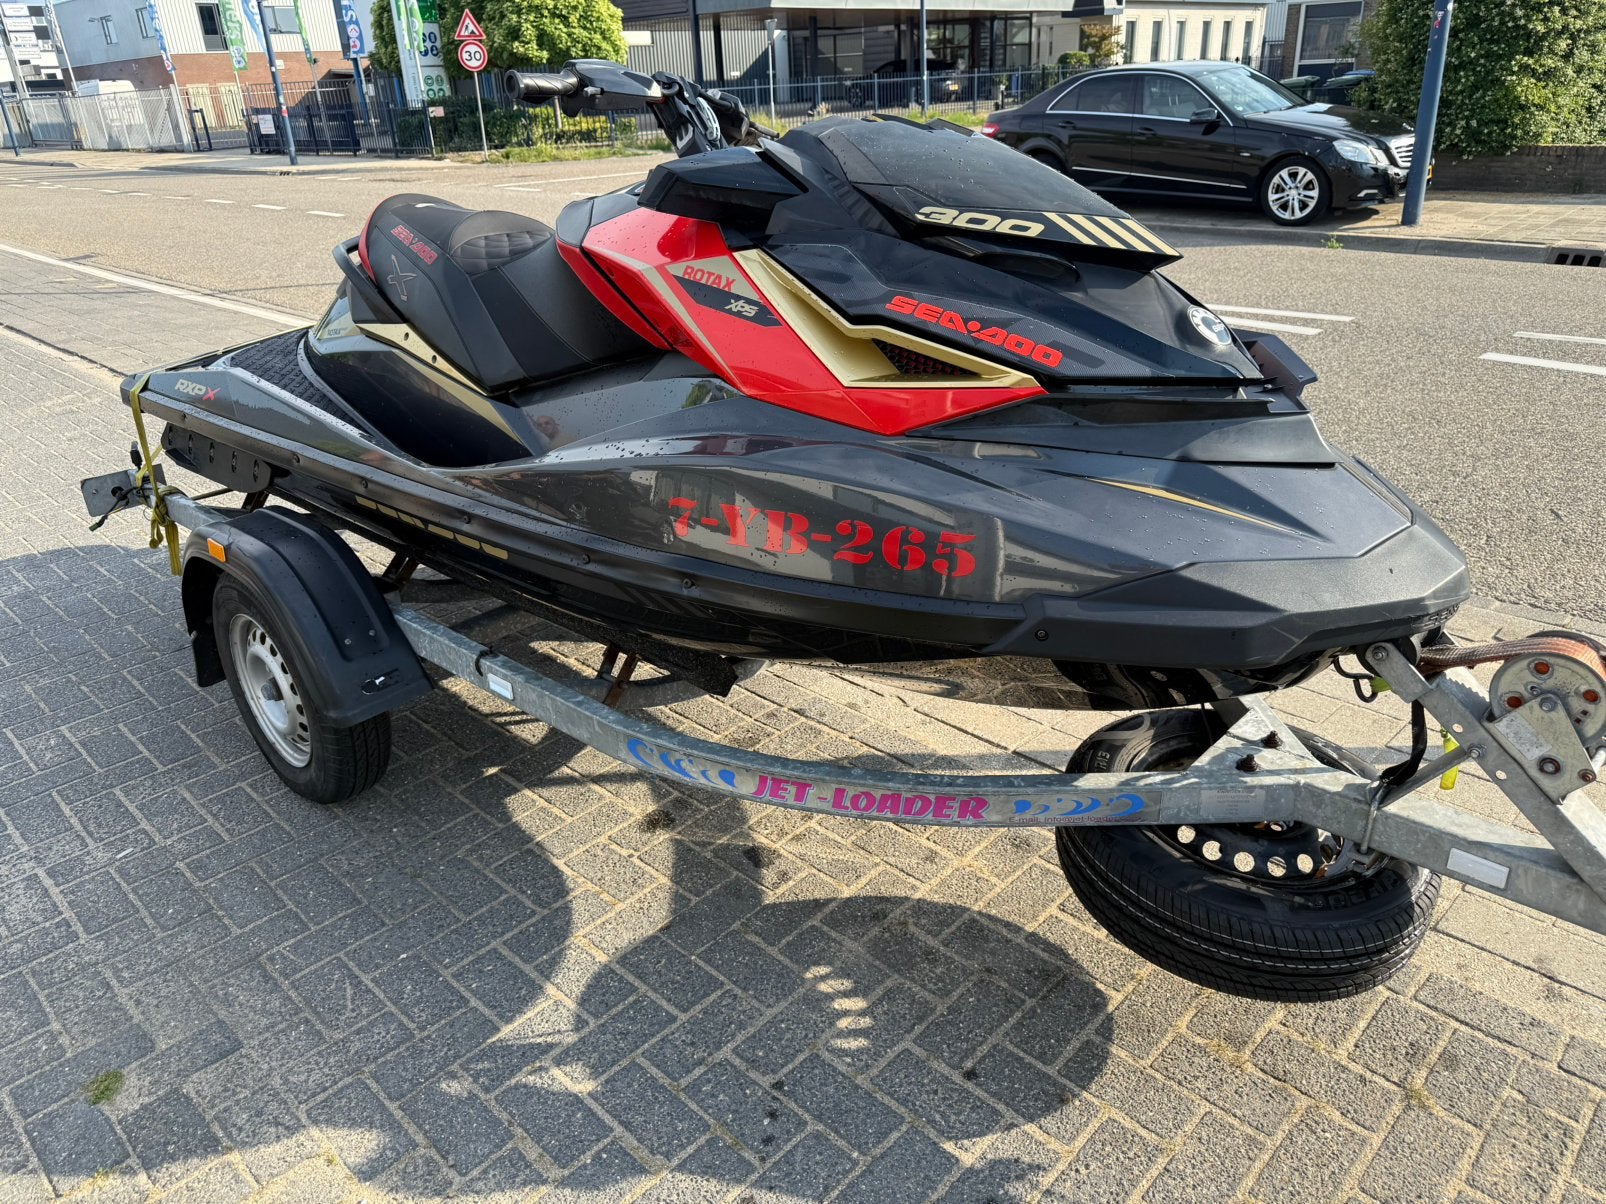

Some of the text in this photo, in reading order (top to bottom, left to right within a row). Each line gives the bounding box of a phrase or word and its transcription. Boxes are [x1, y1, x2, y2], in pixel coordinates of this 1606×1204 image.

[464, 50, 482, 62] 30
[915, 206, 1045, 237] 300
[682, 265, 736, 293] ROTAX
[724, 299, 759, 317] XPS
[669, 496, 977, 578] 7-YB-265
